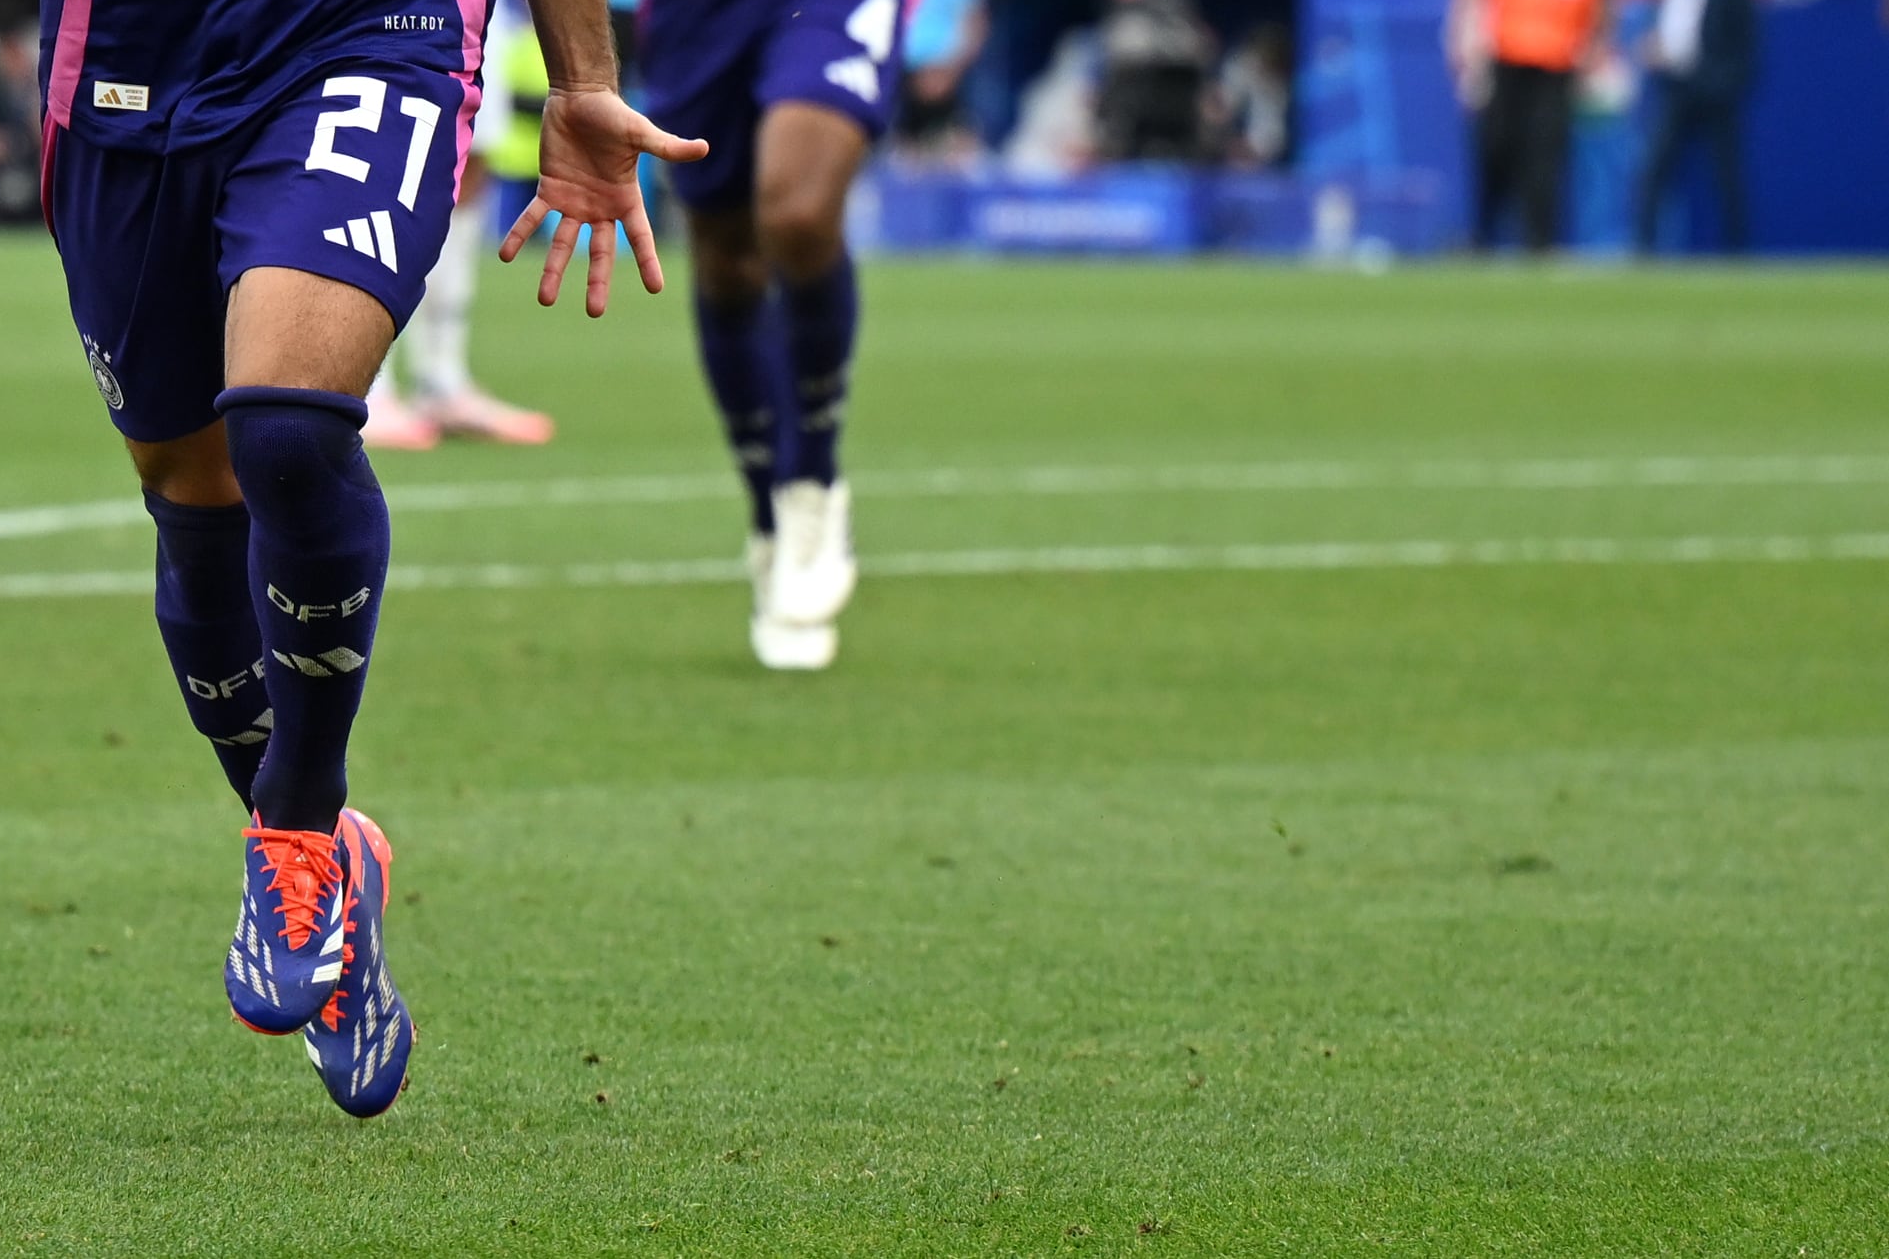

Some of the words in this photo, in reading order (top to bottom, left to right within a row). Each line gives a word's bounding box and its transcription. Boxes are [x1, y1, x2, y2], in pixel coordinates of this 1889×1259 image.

[384, 15, 445, 31] HEAT.RDY
[305, 76, 442, 213] 21
[267, 582, 371, 623] DFB
